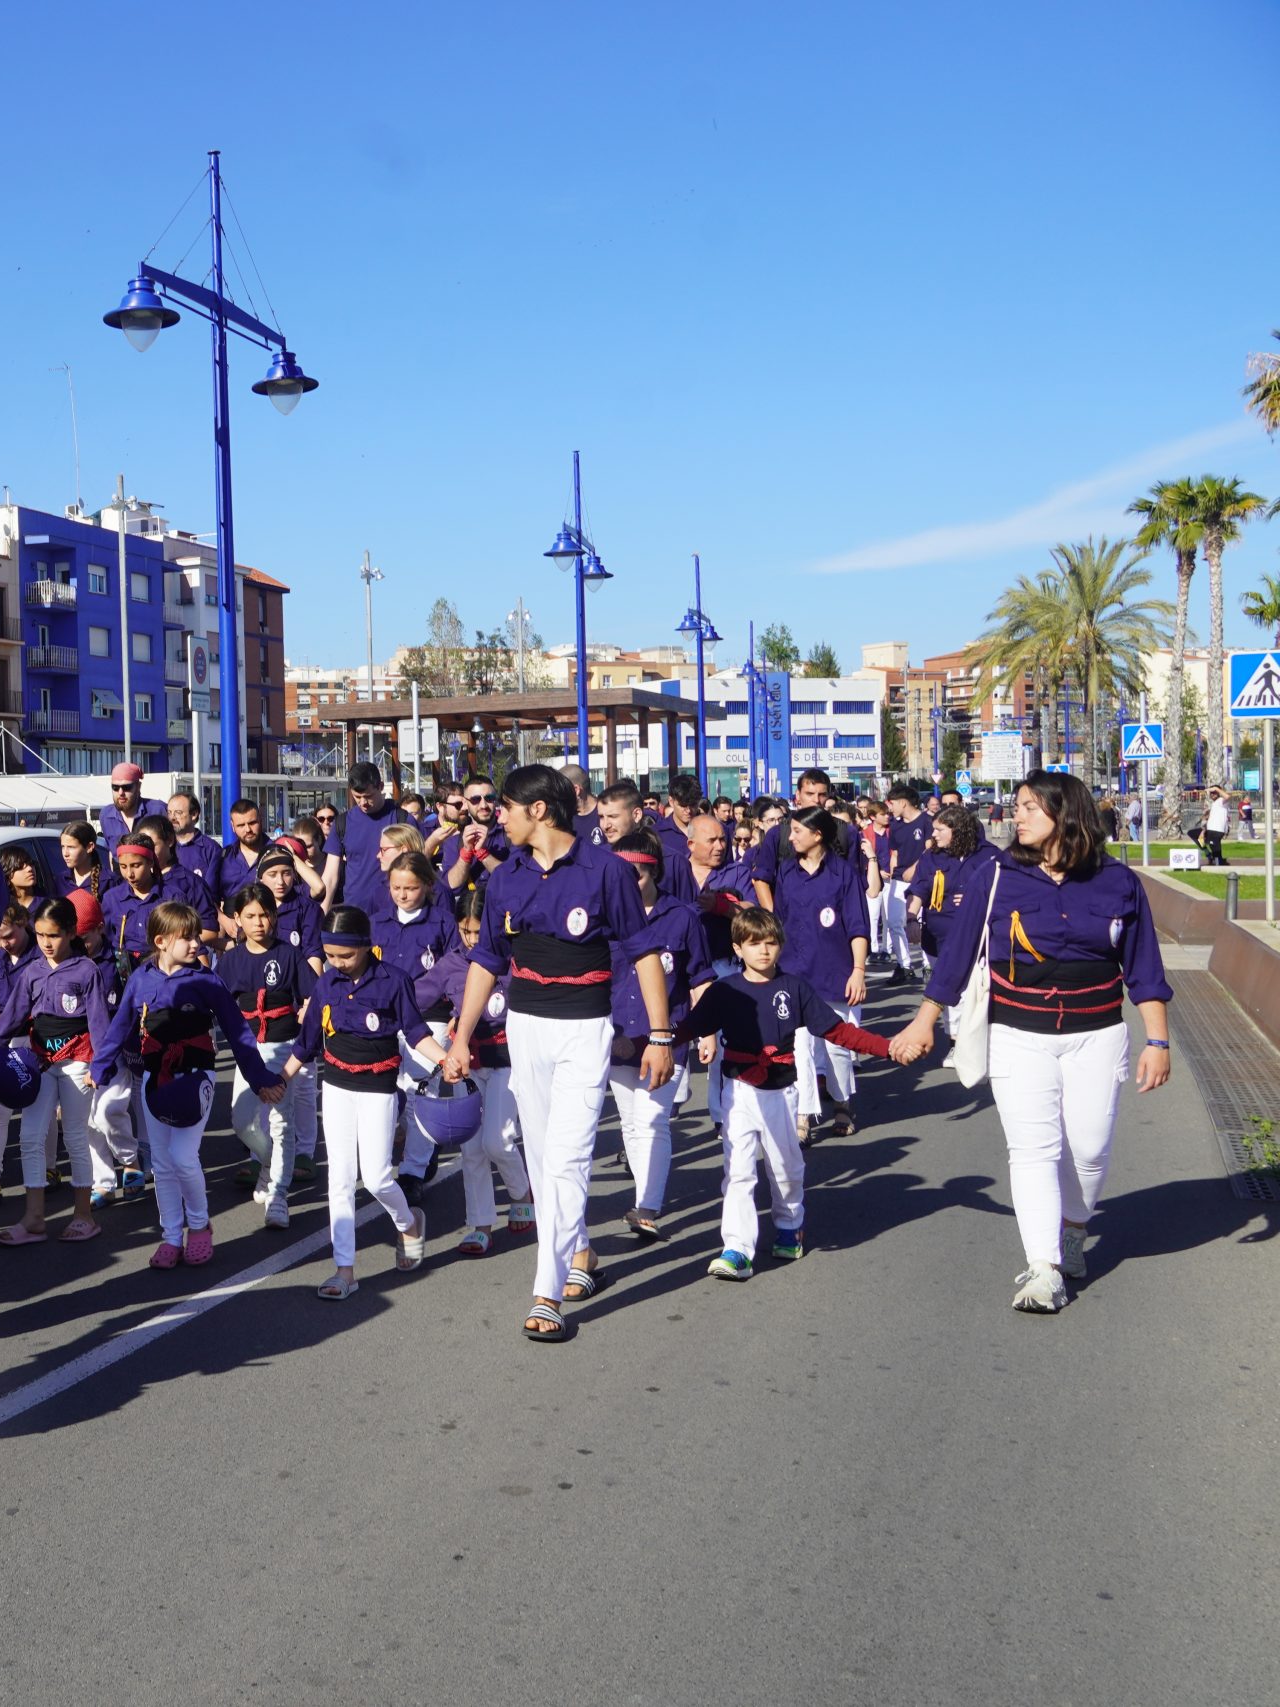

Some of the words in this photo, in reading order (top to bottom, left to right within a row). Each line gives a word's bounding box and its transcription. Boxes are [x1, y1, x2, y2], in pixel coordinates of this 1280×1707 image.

[725, 754, 748, 763] COLL
[804, 753, 824, 762] DEL
[828, 752, 879, 761] SERRALLO
